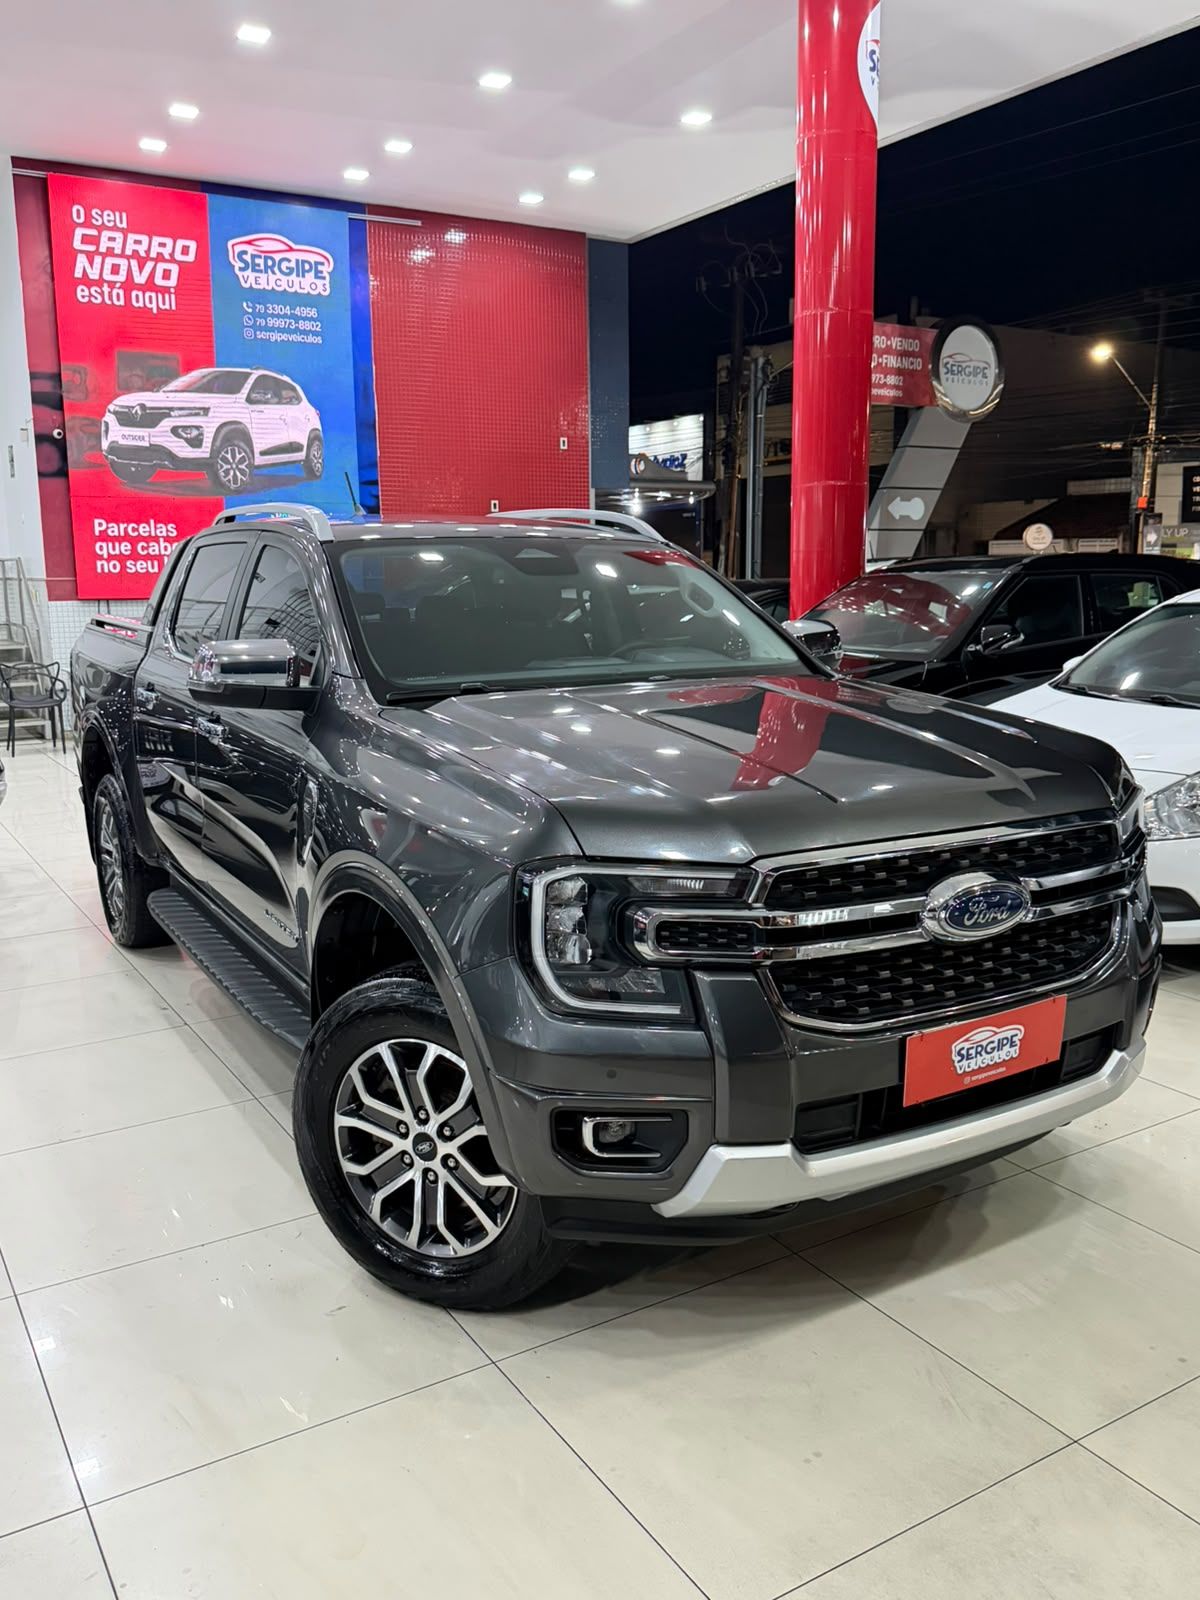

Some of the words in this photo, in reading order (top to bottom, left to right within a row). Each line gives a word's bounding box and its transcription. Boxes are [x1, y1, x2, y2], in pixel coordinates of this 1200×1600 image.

[91, 208, 127, 229] seu
[72, 226, 198, 263] CARRO
[74, 253, 180, 288] NOVO
[236, 249, 327, 280] SERGIPE
[76, 282, 126, 307] está
[131, 287, 177, 314] aqui
[266, 303, 318, 318] 3304-4956
[267, 317, 321, 331] 99973-8802
[943, 361, 989, 380] SERGIPE
[93, 518, 178, 537] Parcelas
[94, 540, 132, 559] que
[96, 559, 121, 574] no
[125, 559, 159, 574] seu
[963, 895, 1012, 926] Ford
[956, 1033, 1019, 1064] SERGIPE
